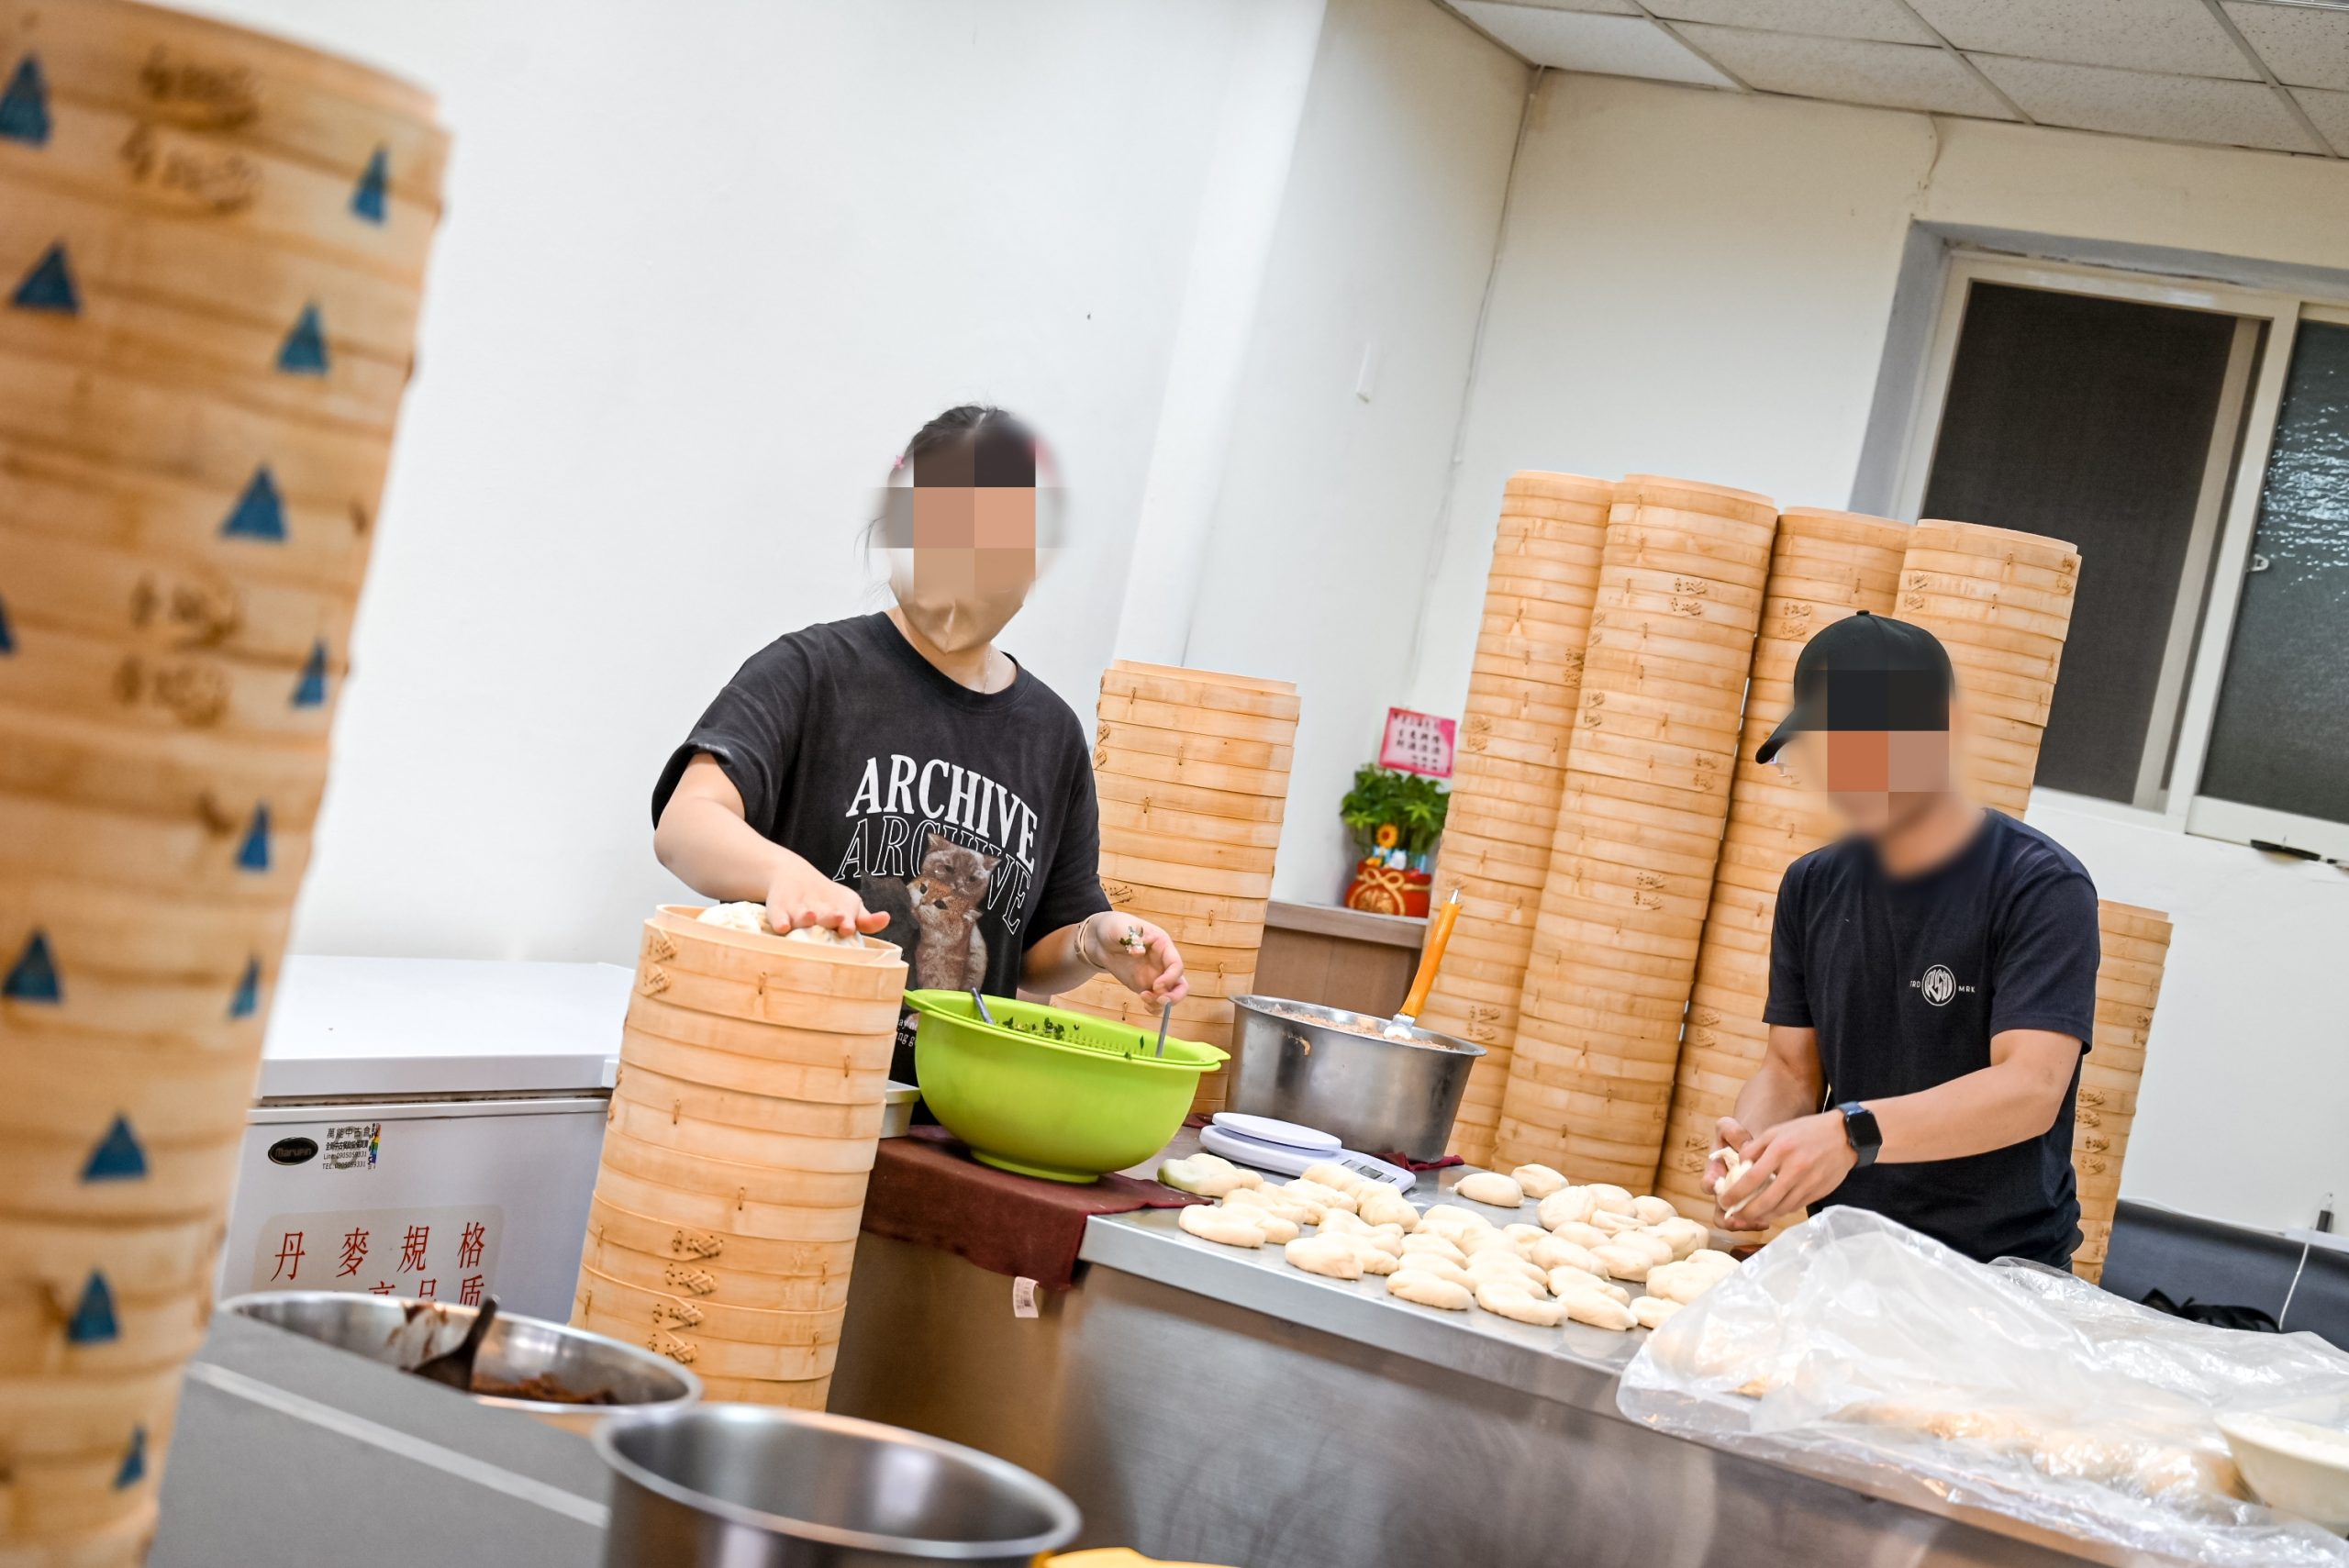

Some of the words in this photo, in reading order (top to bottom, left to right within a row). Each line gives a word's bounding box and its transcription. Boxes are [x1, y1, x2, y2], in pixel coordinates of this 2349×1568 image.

[846, 754, 1038, 871] ARCHIVE
[1958, 984, 1976, 993] MRK
[271, 1221, 485, 1282] 丹麥規格
